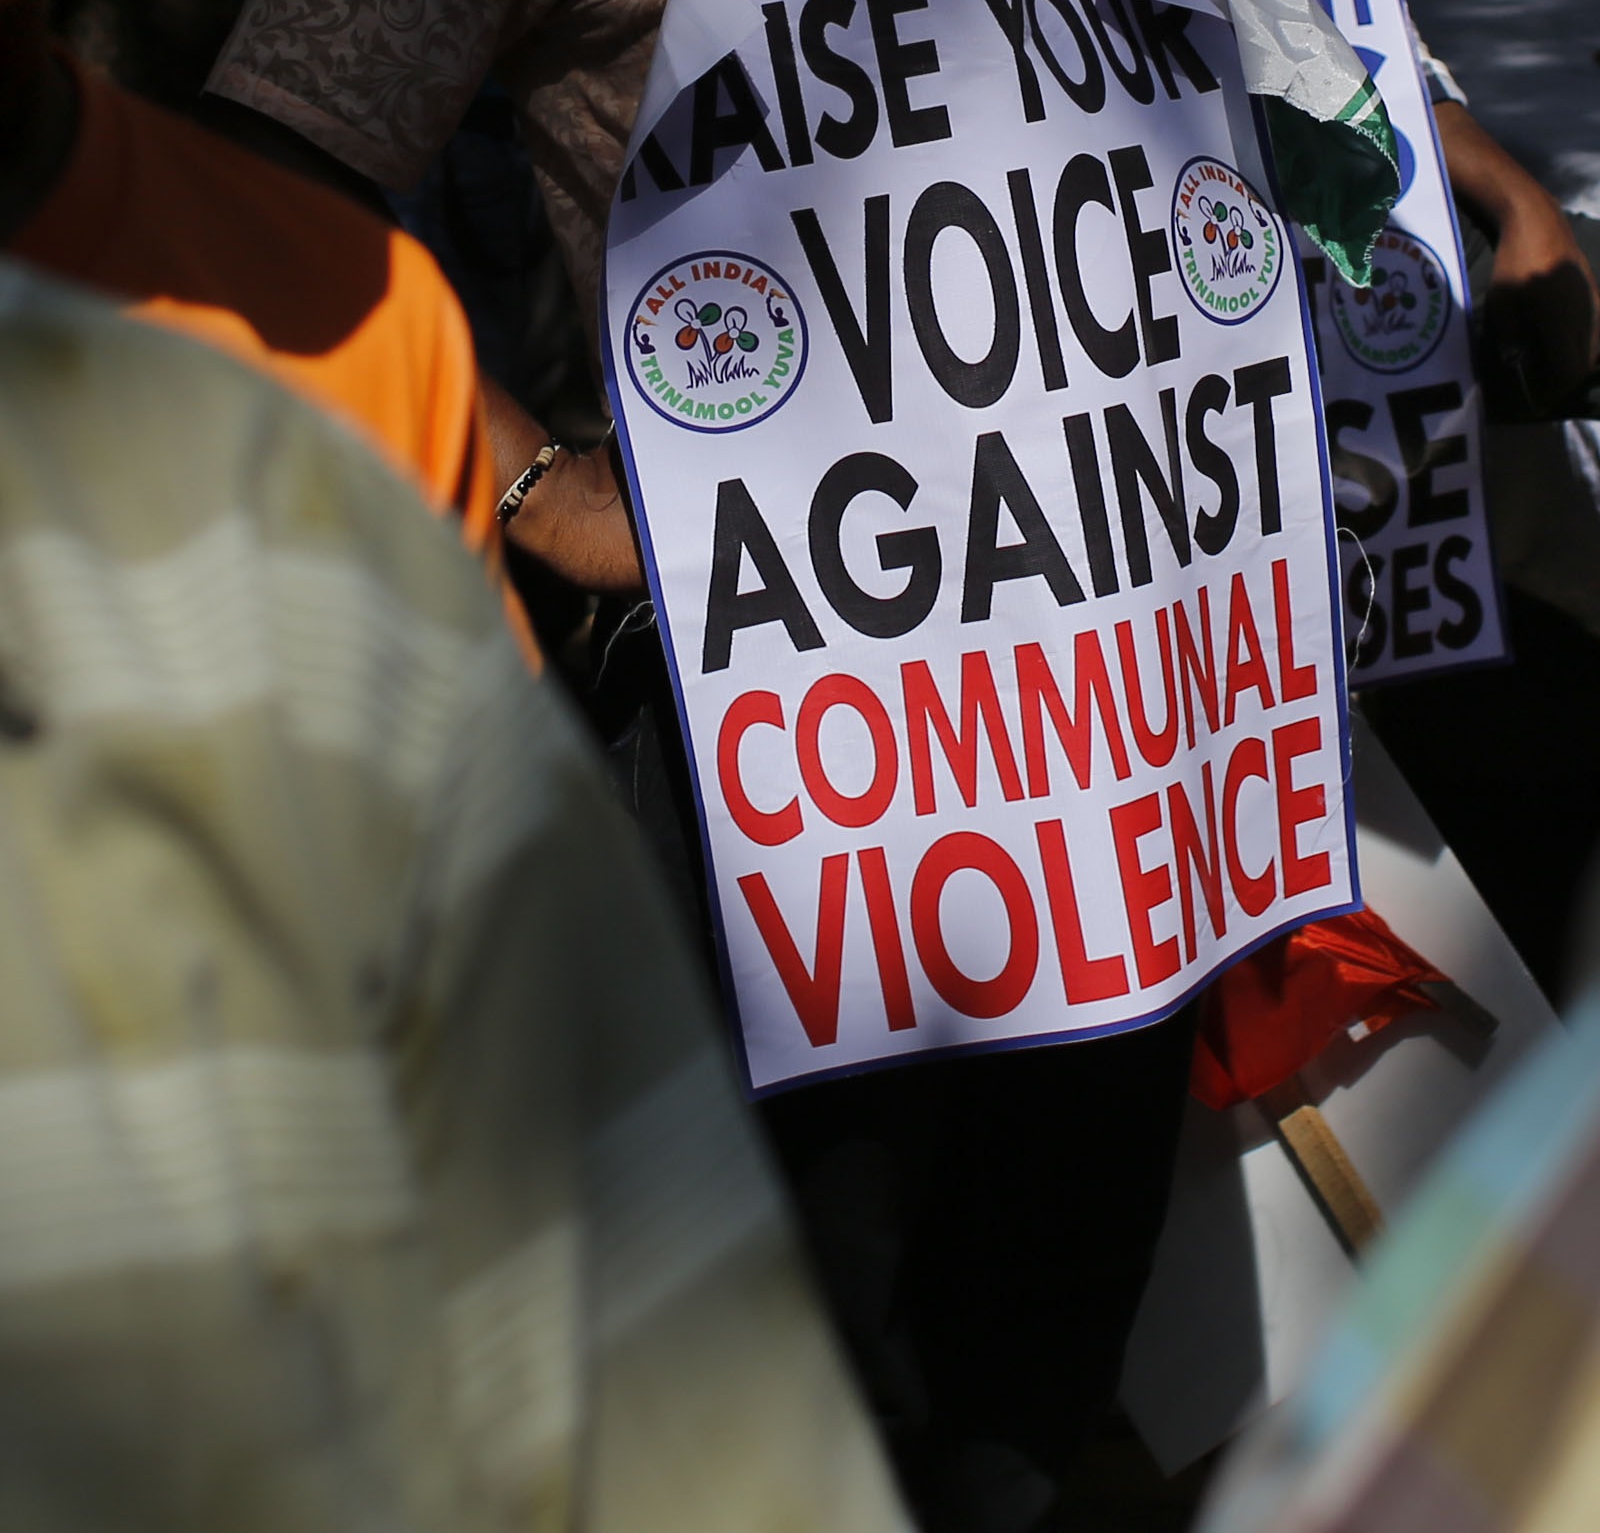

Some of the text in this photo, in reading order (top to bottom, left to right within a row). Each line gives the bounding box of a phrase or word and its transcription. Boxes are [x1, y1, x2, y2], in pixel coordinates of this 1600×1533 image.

[1180, 165, 1245, 209] ALL INDIA
[1183, 228, 1276, 312] TRINAMOOL YUVA
[640, 328, 794, 420] TRINAMOOL YUVA
[645, 261, 768, 315] ALL INDIA
[790, 144, 1180, 424] VOICE
[702, 356, 1292, 674] AGAINST
[717, 559, 1317, 846] COMMUNAL
[737, 716, 1331, 1048] VIOLENCE
